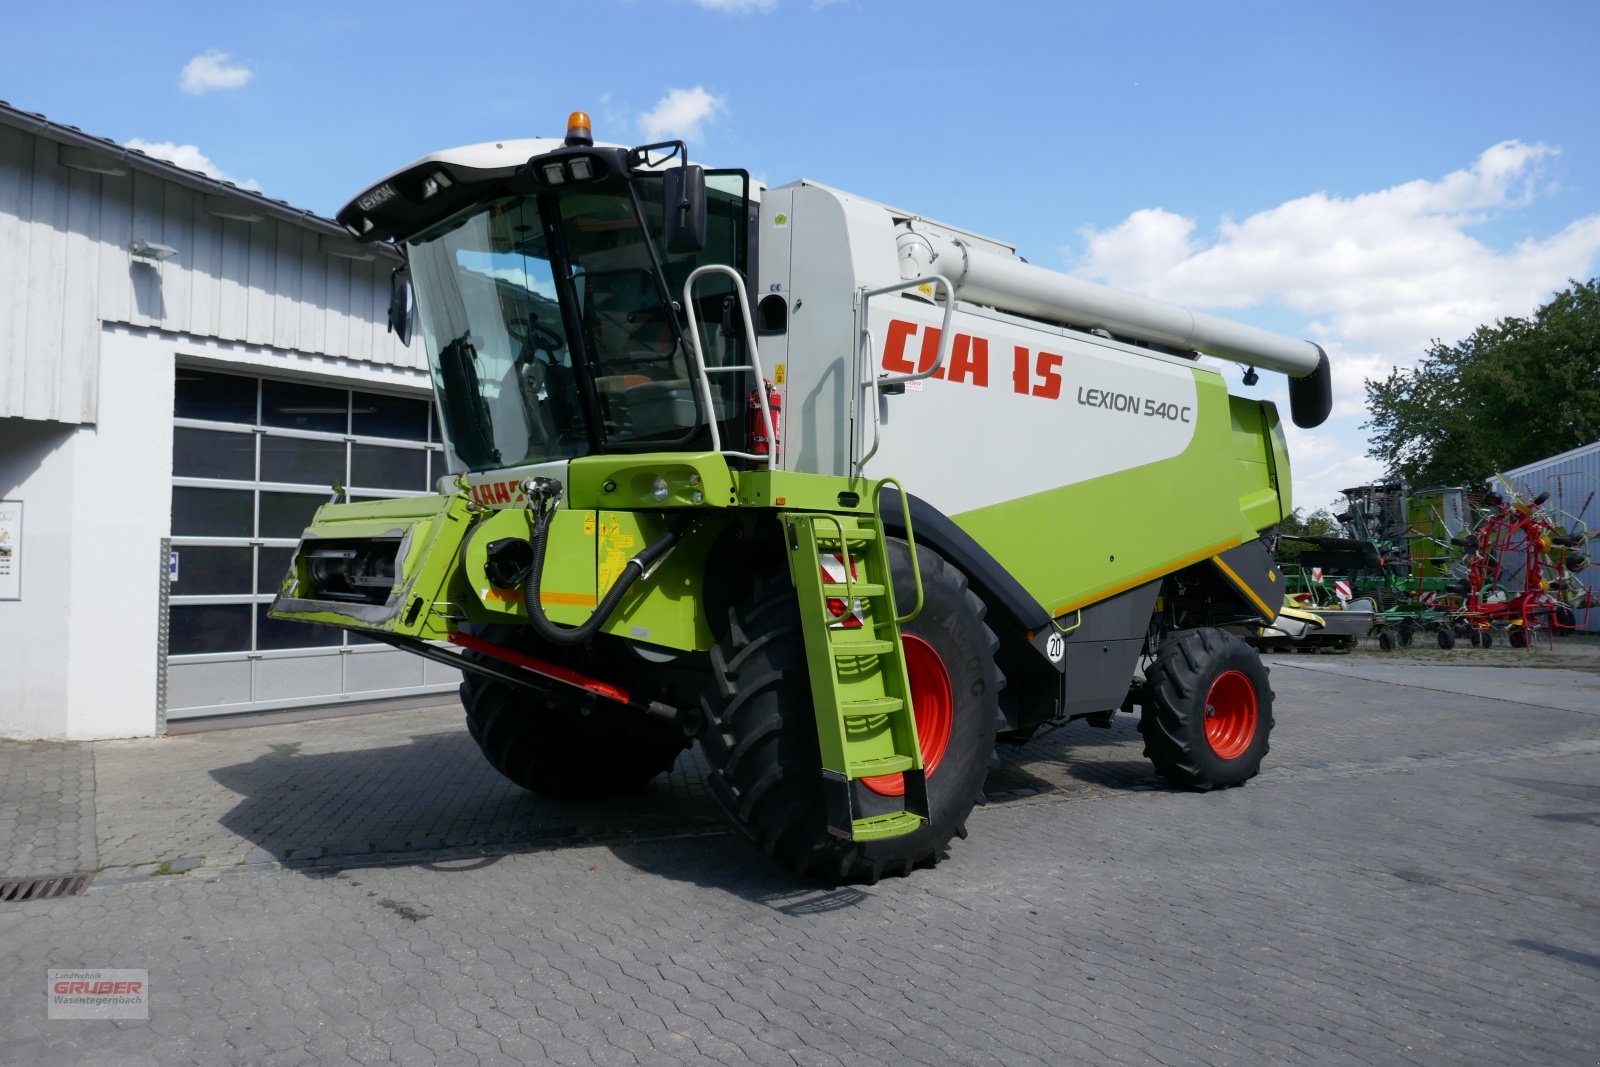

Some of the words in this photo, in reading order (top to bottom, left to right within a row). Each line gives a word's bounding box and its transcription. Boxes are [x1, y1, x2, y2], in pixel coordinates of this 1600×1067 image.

[358, 184, 396, 211] LEXION
[1077, 386, 1141, 414] LEXION
[472, 480, 524, 505] LAA
[1050, 638, 1061, 657] 20
